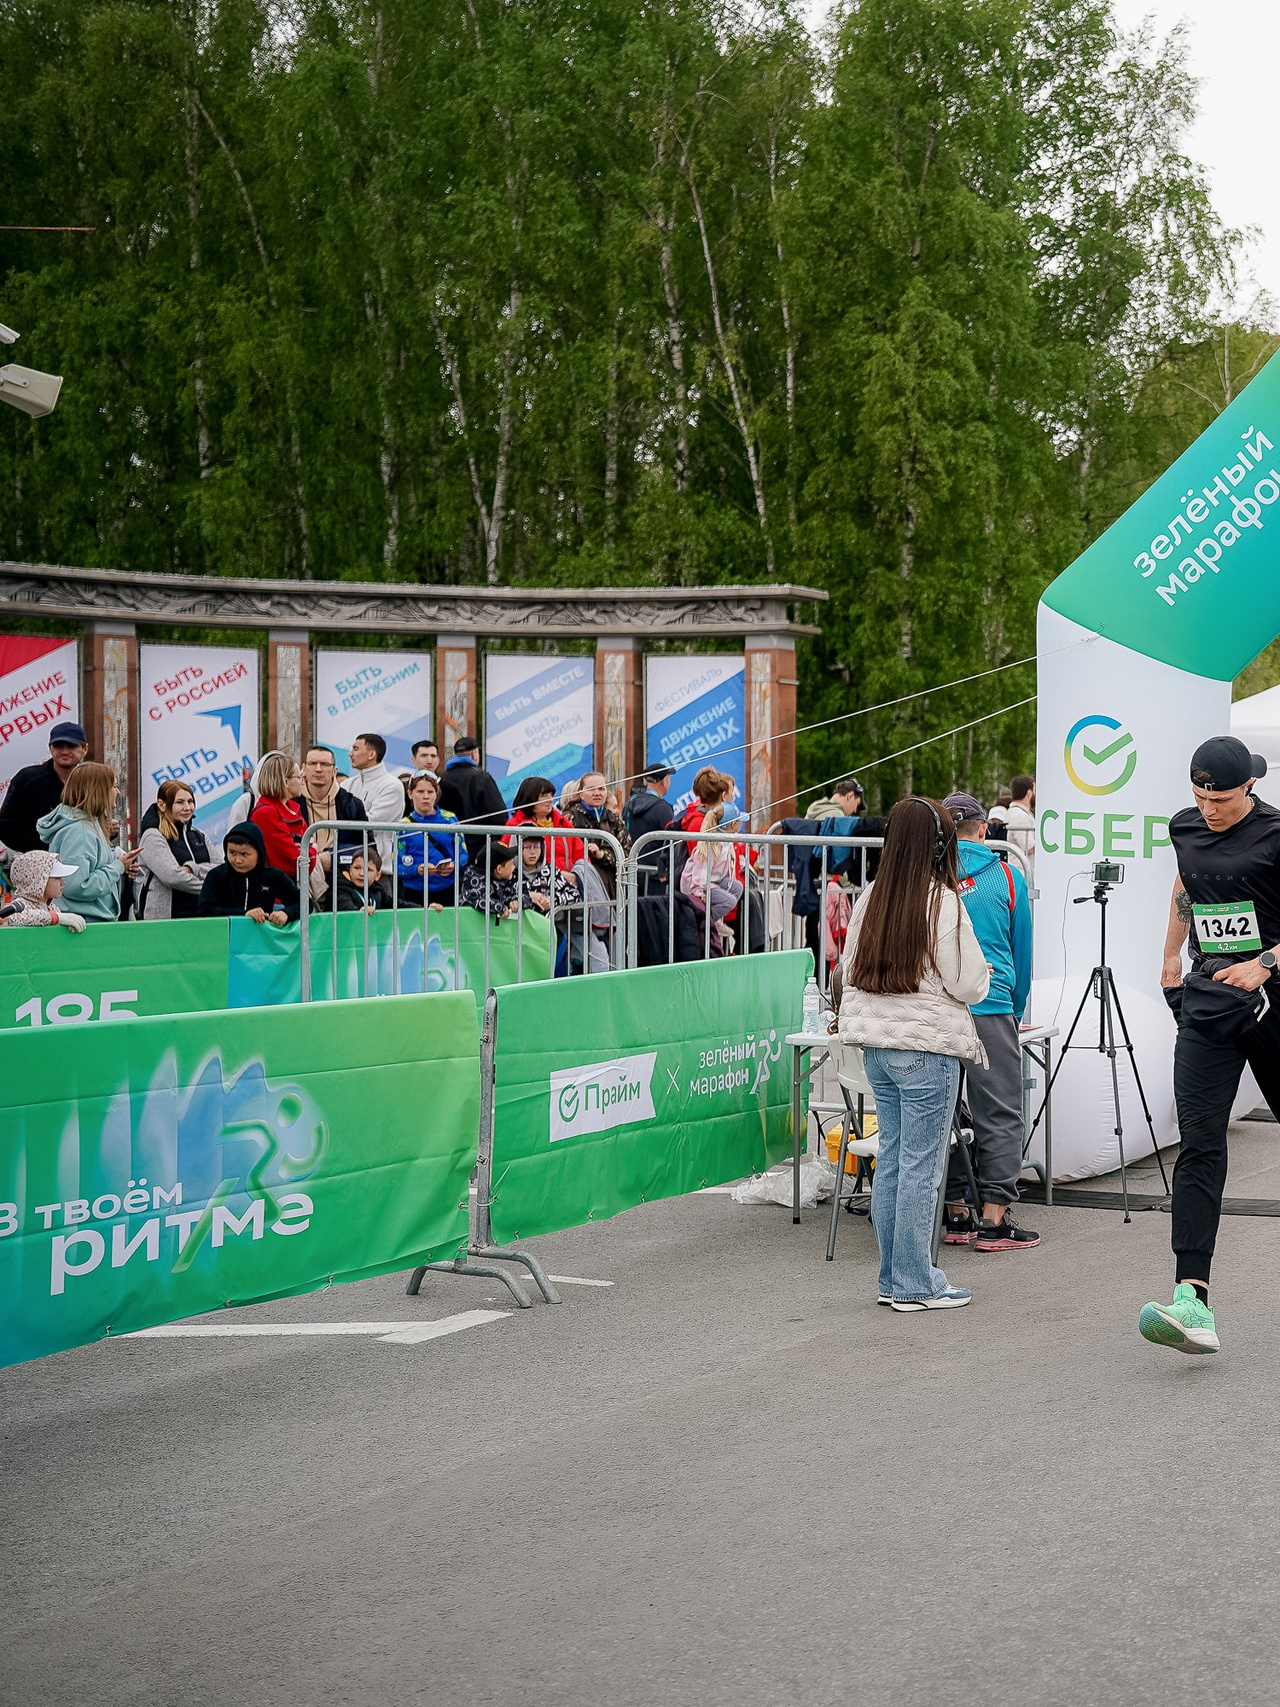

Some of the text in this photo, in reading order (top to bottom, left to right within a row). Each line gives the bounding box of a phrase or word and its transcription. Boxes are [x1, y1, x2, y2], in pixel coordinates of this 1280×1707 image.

[1133, 424, 1275, 578] зелёный
[148, 660, 249, 721] С РОССИЕЙ
[153, 665, 204, 697] БЫТЬ
[334, 666, 382, 695] БЫТЬ
[341, 662, 421, 711] ДВИЖЕНИИ
[494, 665, 585, 721] БЫТЬ ВМЕСТЕ
[654, 667, 723, 712] ФЕСТИВАЛЬ
[0, 695, 73, 748] РВЫХ
[659, 696, 737, 754] ДВИЖЕНИЕ
[151, 747, 219, 787] БЫТЬ
[1040, 809, 1173, 859] СБЕР
[1201, 916, 1252, 938] 1342
[699, 1034, 756, 1069] зелёный
[584, 1075, 641, 1114] Прайм
[690, 1065, 750, 1098] марафон
[35, 1178, 183, 1229] твоём
[50, 1192, 314, 1296] ритме
